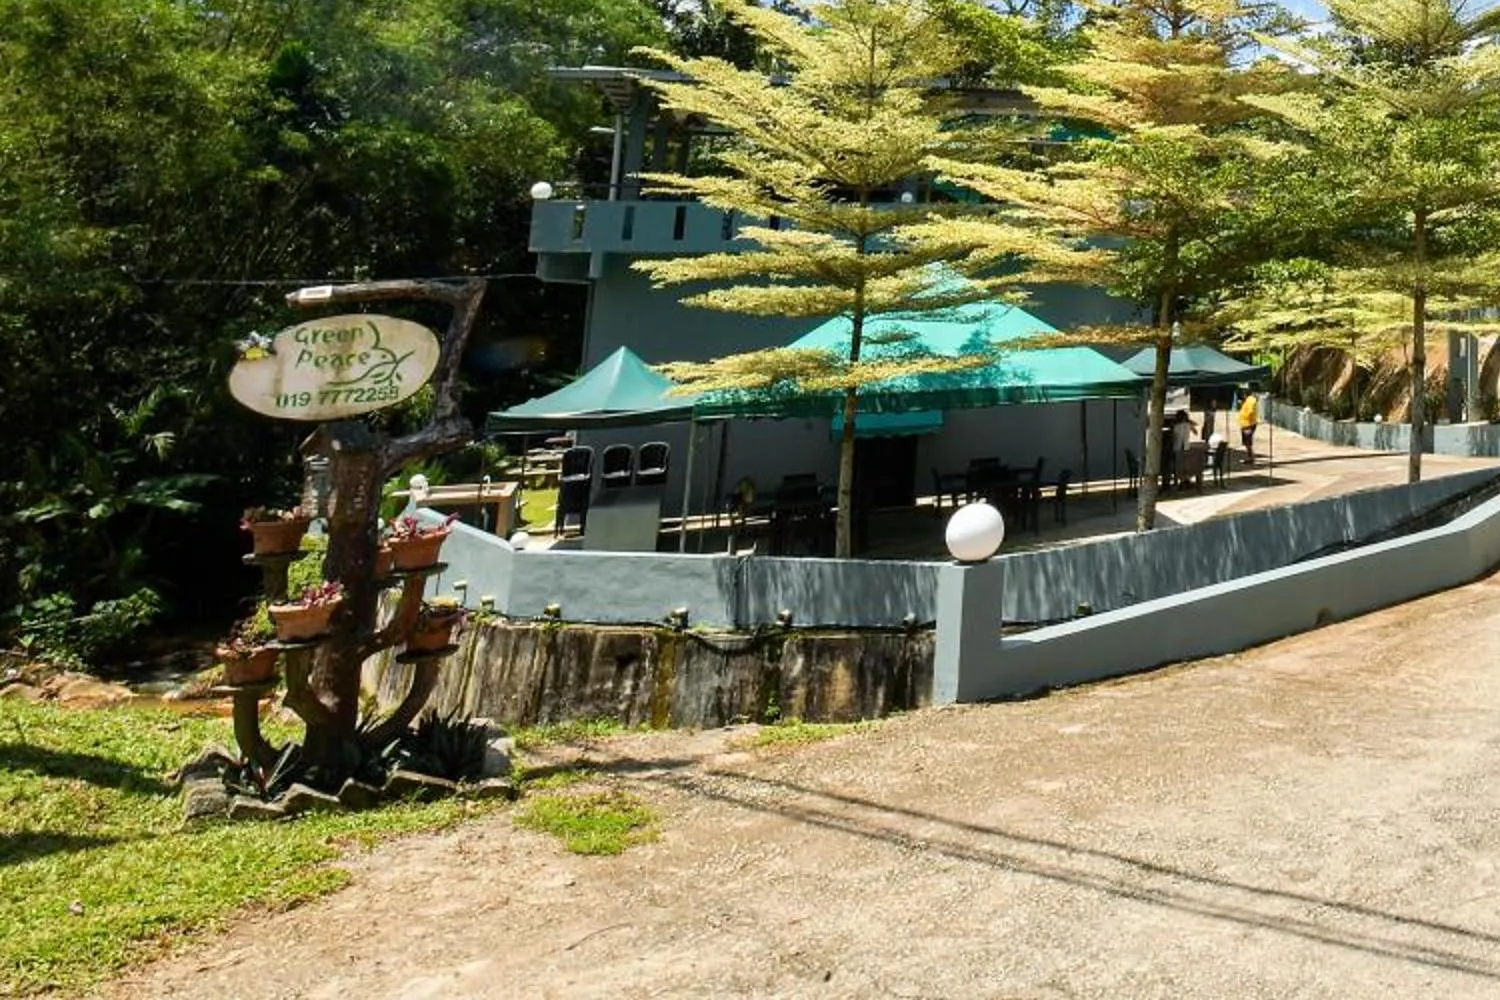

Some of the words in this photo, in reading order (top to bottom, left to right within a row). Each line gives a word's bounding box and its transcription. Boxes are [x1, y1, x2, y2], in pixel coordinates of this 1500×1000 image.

[294, 326, 363, 345] Green
[294, 348, 371, 369] Peace
[275, 391, 311, 409] 019
